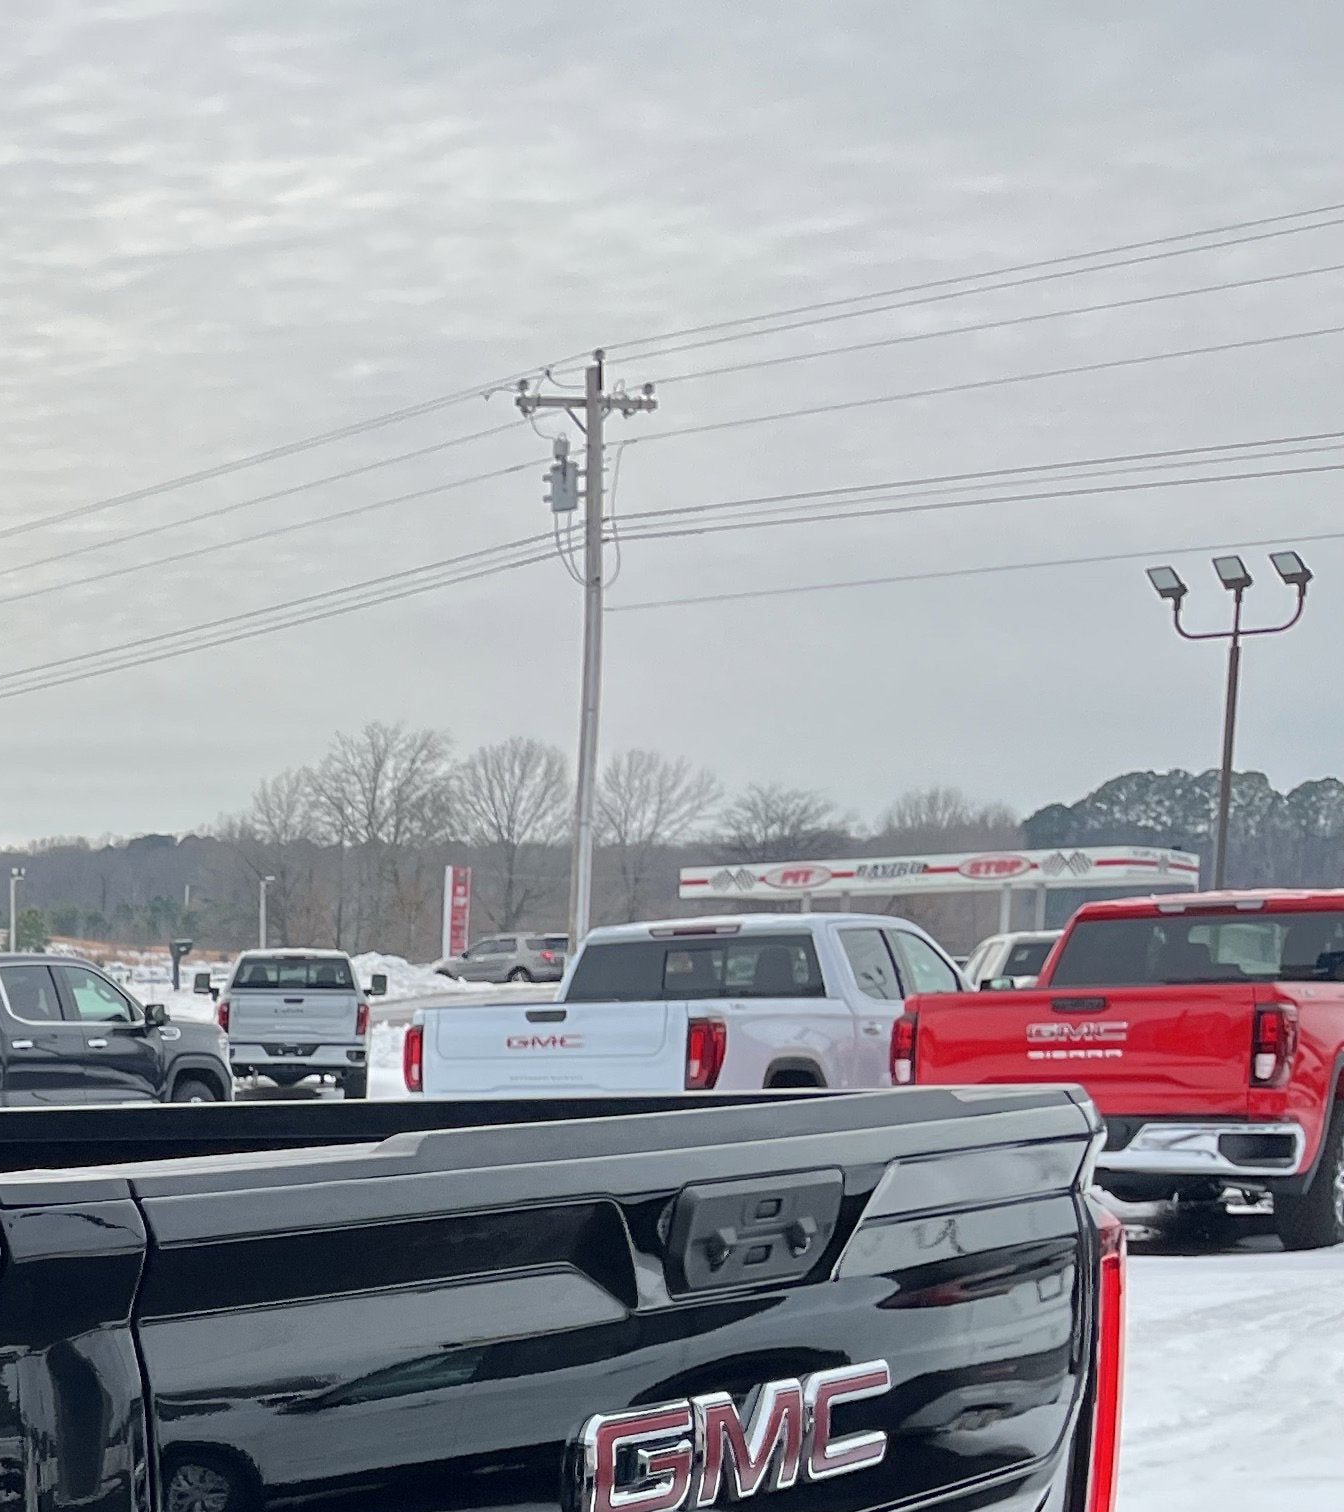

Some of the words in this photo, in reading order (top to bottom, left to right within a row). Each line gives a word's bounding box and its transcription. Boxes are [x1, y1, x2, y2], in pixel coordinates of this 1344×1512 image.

[969, 859, 1023, 875] STOP
[780, 869, 815, 885] PIT
[1026, 1021, 1129, 1043] GMC
[505, 1034, 587, 1050] GMC
[1027, 1048, 1124, 1060] SIERRA
